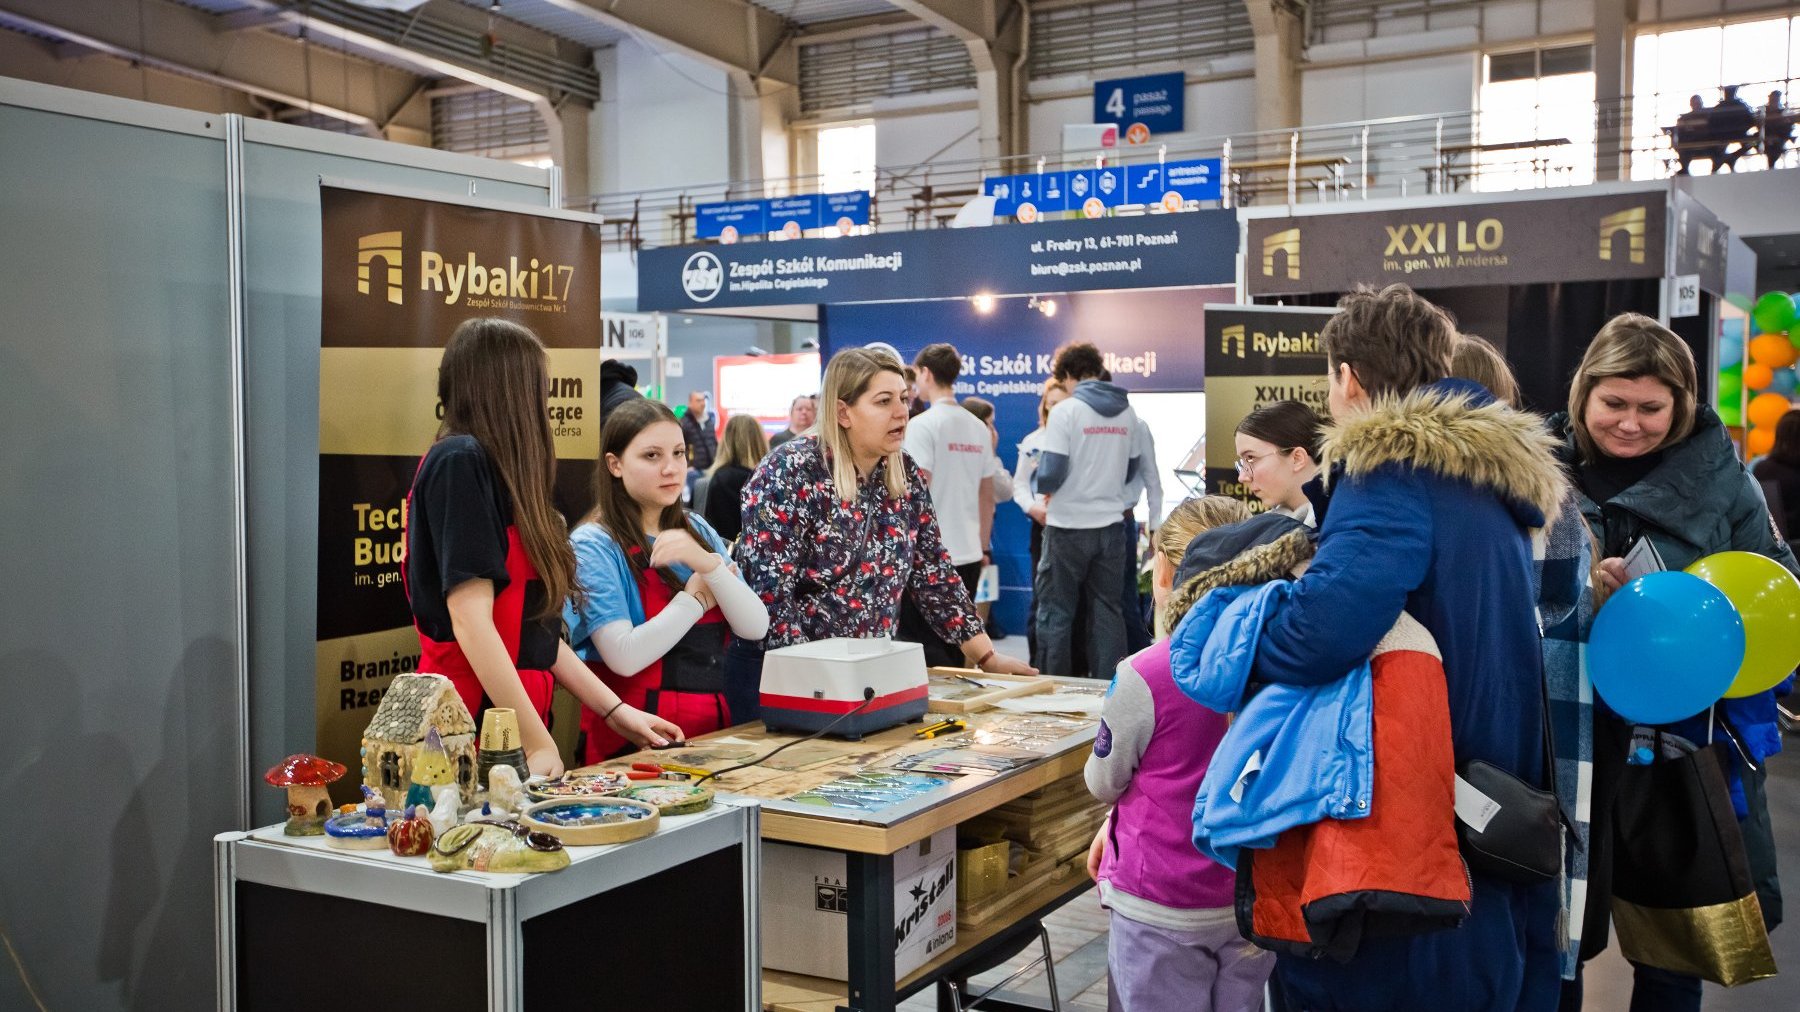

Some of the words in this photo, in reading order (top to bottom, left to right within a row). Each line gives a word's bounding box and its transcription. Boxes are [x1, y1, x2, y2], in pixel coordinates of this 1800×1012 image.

[1106, 88, 1126, 118] 4
[1046, 236, 1082, 253] Fredry
[1084, 235, 1098, 250] 13,
[1100, 233, 1133, 248] 61-701
[1135, 230, 1179, 246] Poznań
[1384, 222, 1447, 256] XXI
[1457, 218, 1504, 252] LO
[729, 258, 774, 280] Zespół
[776, 256, 814, 275] Szkół
[816, 252, 903, 272] Komunikacji
[1031, 258, 1142, 277] biuro@zsk.poznan.pl
[1383, 258, 1402, 272] im.
[1404, 258, 1431, 274] gen.
[1457, 254, 1508, 267] Andersa
[421, 250, 574, 305] Rybaki17
[1679, 285, 1695, 299] 105
[466, 297, 490, 309] Zespół
[491, 299, 508, 308] Szkół
[509, 301, 551, 312] Budownictwa
[553, 304, 561, 312] Nr
[562, 304, 567, 313] 1
[629, 329, 645, 339] 106
[980, 353, 1032, 376] Szkół
[977, 381, 1046, 397] Cegielskieg
[1255, 386, 1285, 401] XXI
[353, 498, 407, 531] Tec
[355, 532, 408, 566] Bud
[355, 572, 374, 586] im.
[377, 571, 402, 588] gen.
[815, 875, 847, 886] FRA
